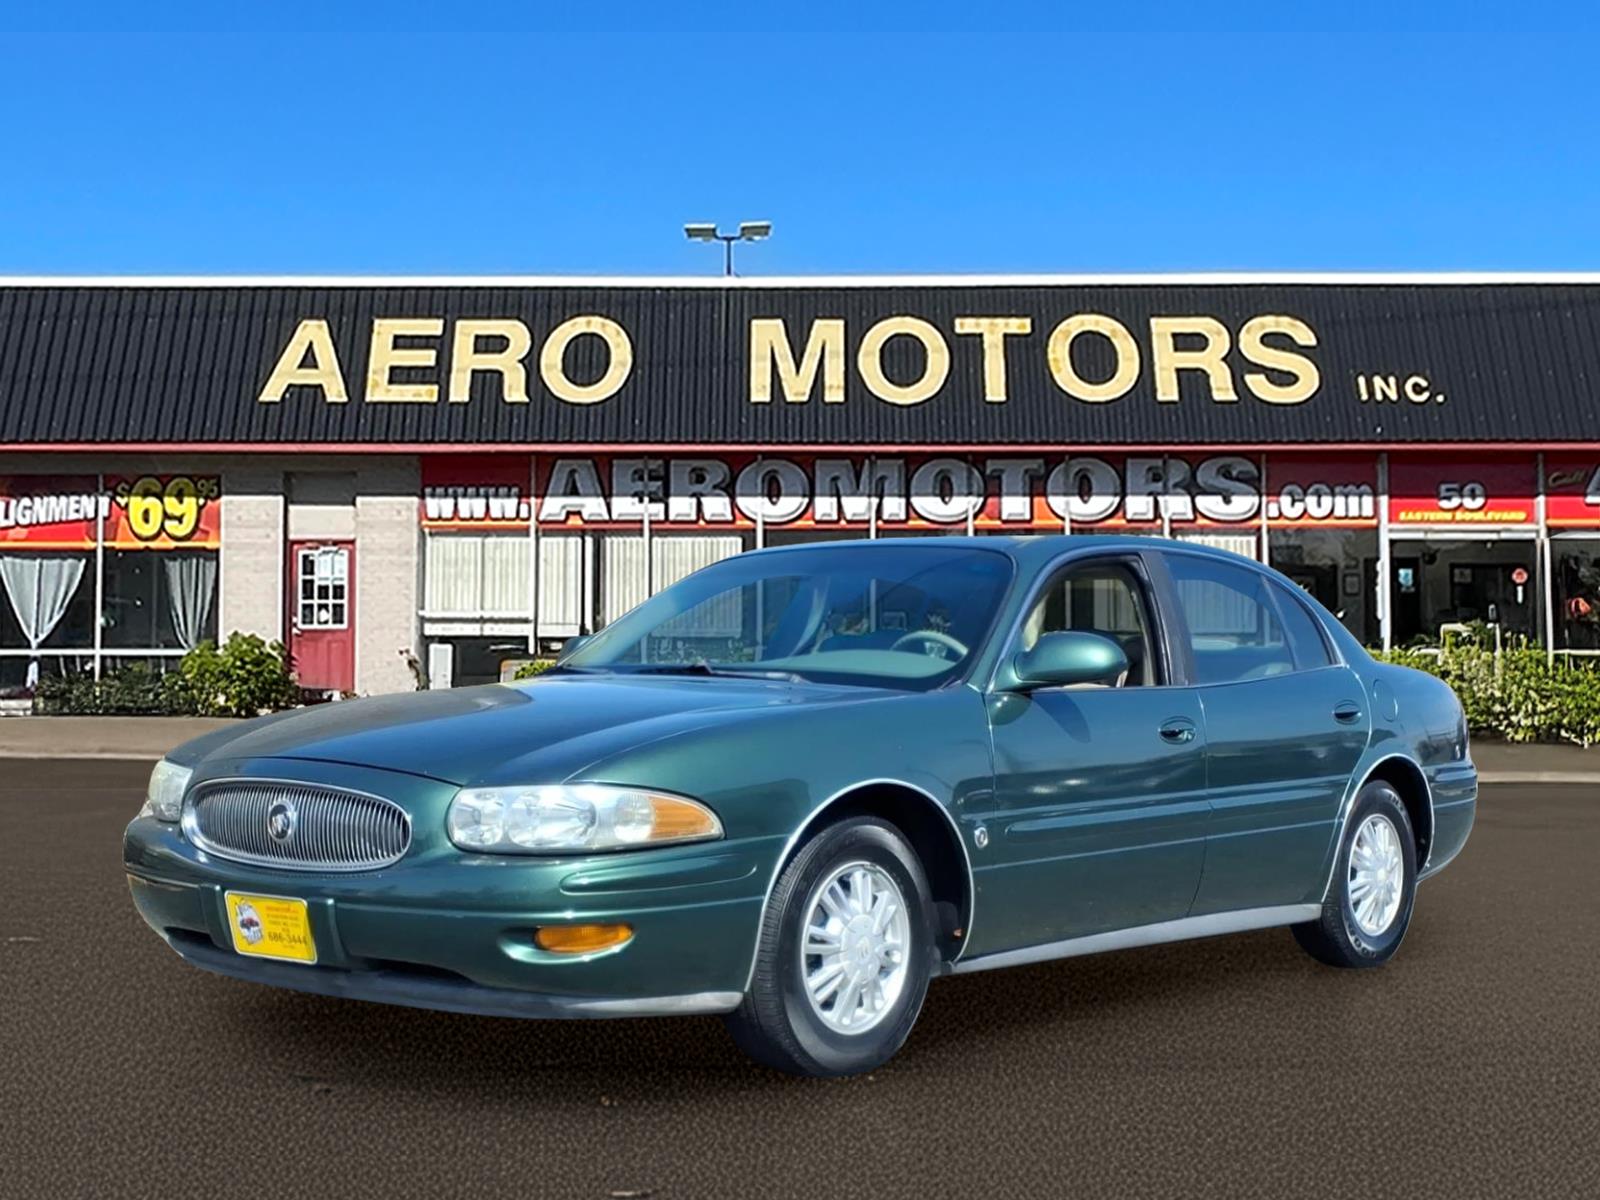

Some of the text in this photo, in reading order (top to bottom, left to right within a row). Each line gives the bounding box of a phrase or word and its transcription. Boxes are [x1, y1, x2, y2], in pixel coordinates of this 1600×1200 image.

[258, 313, 1446, 406] AERO MOTORS INC.
[1437, 482, 1486, 510] 50
